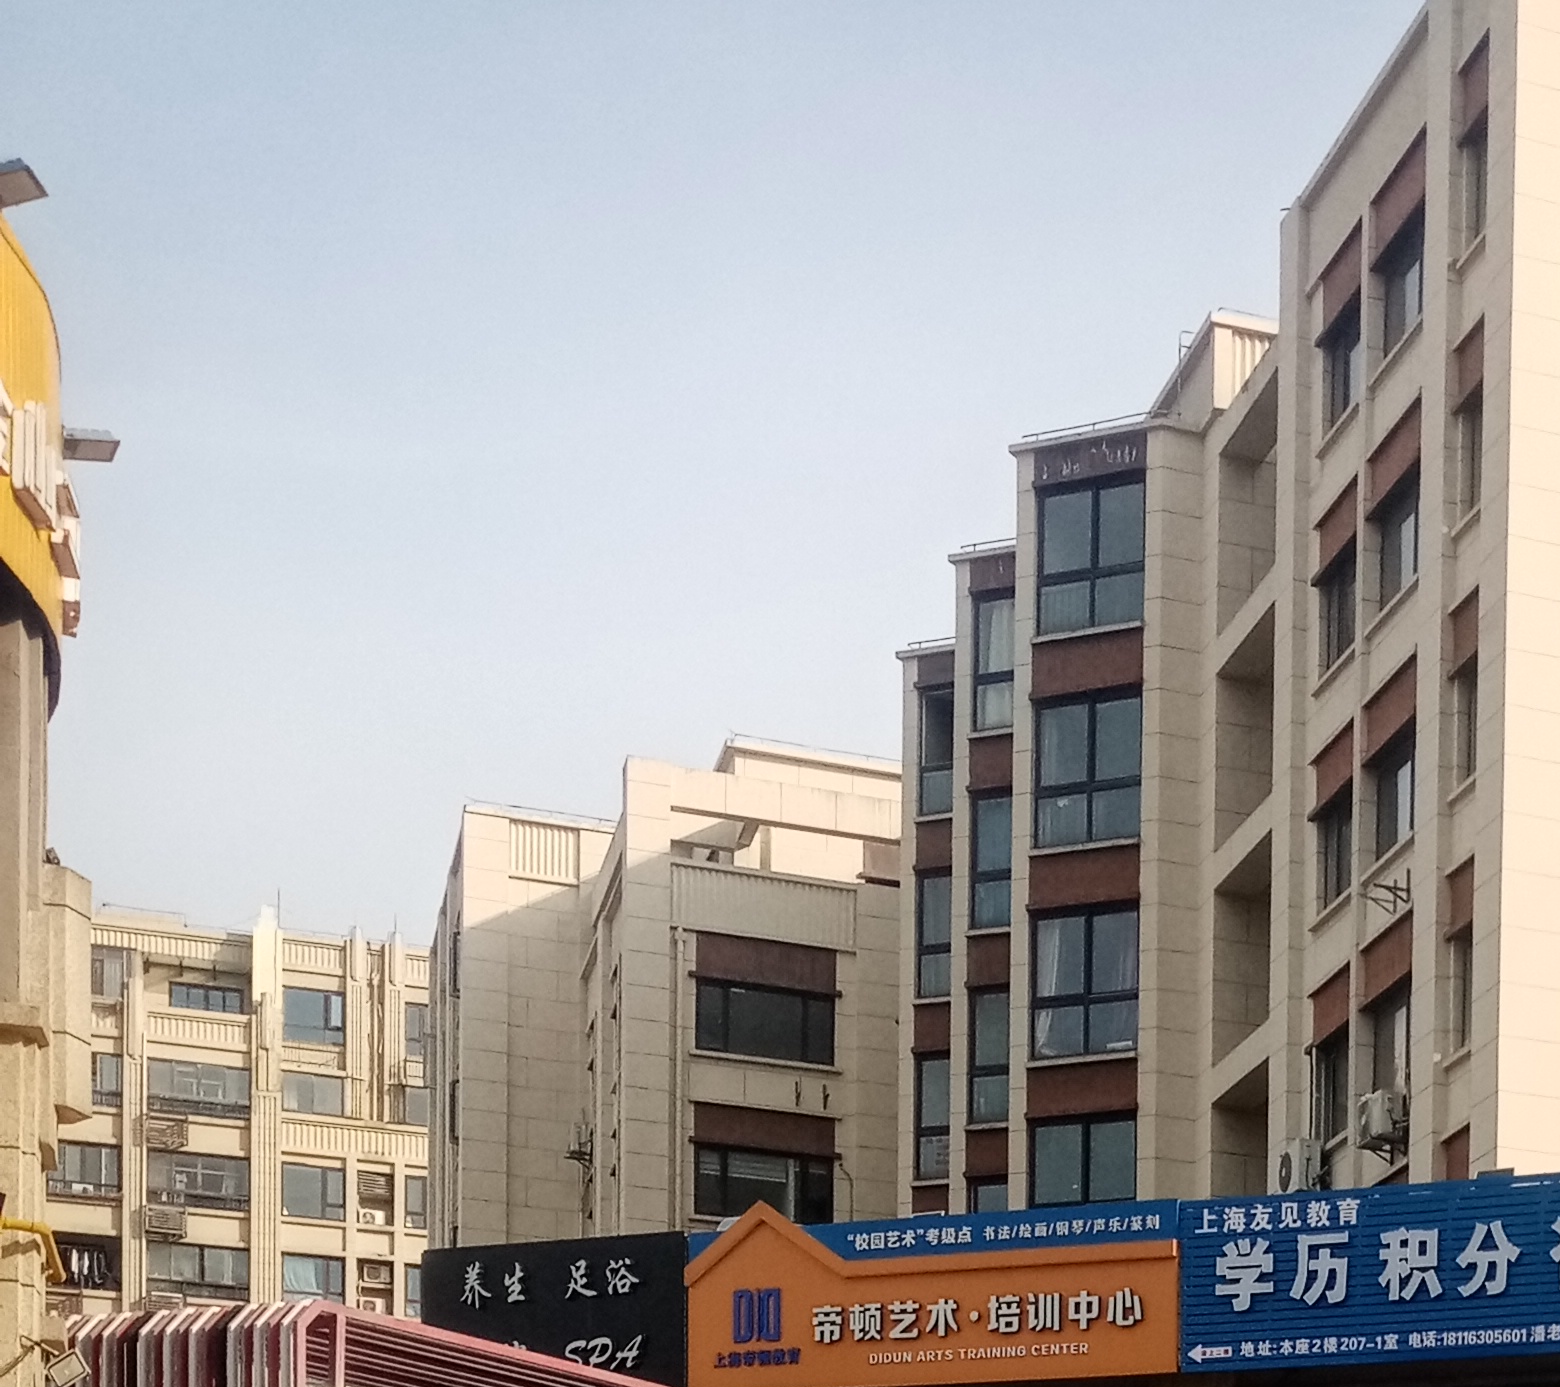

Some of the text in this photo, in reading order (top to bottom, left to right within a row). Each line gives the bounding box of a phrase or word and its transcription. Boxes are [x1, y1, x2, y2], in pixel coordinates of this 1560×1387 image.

[1194, 1198, 1361, 1234] 上海友见教育
[460, 1258, 640, 1310] 养生 足浴
[565, 1334, 643, 1370] SPA
[869, 1342, 1088, 1365] DIDUN ARTS TRAINING CENTER
